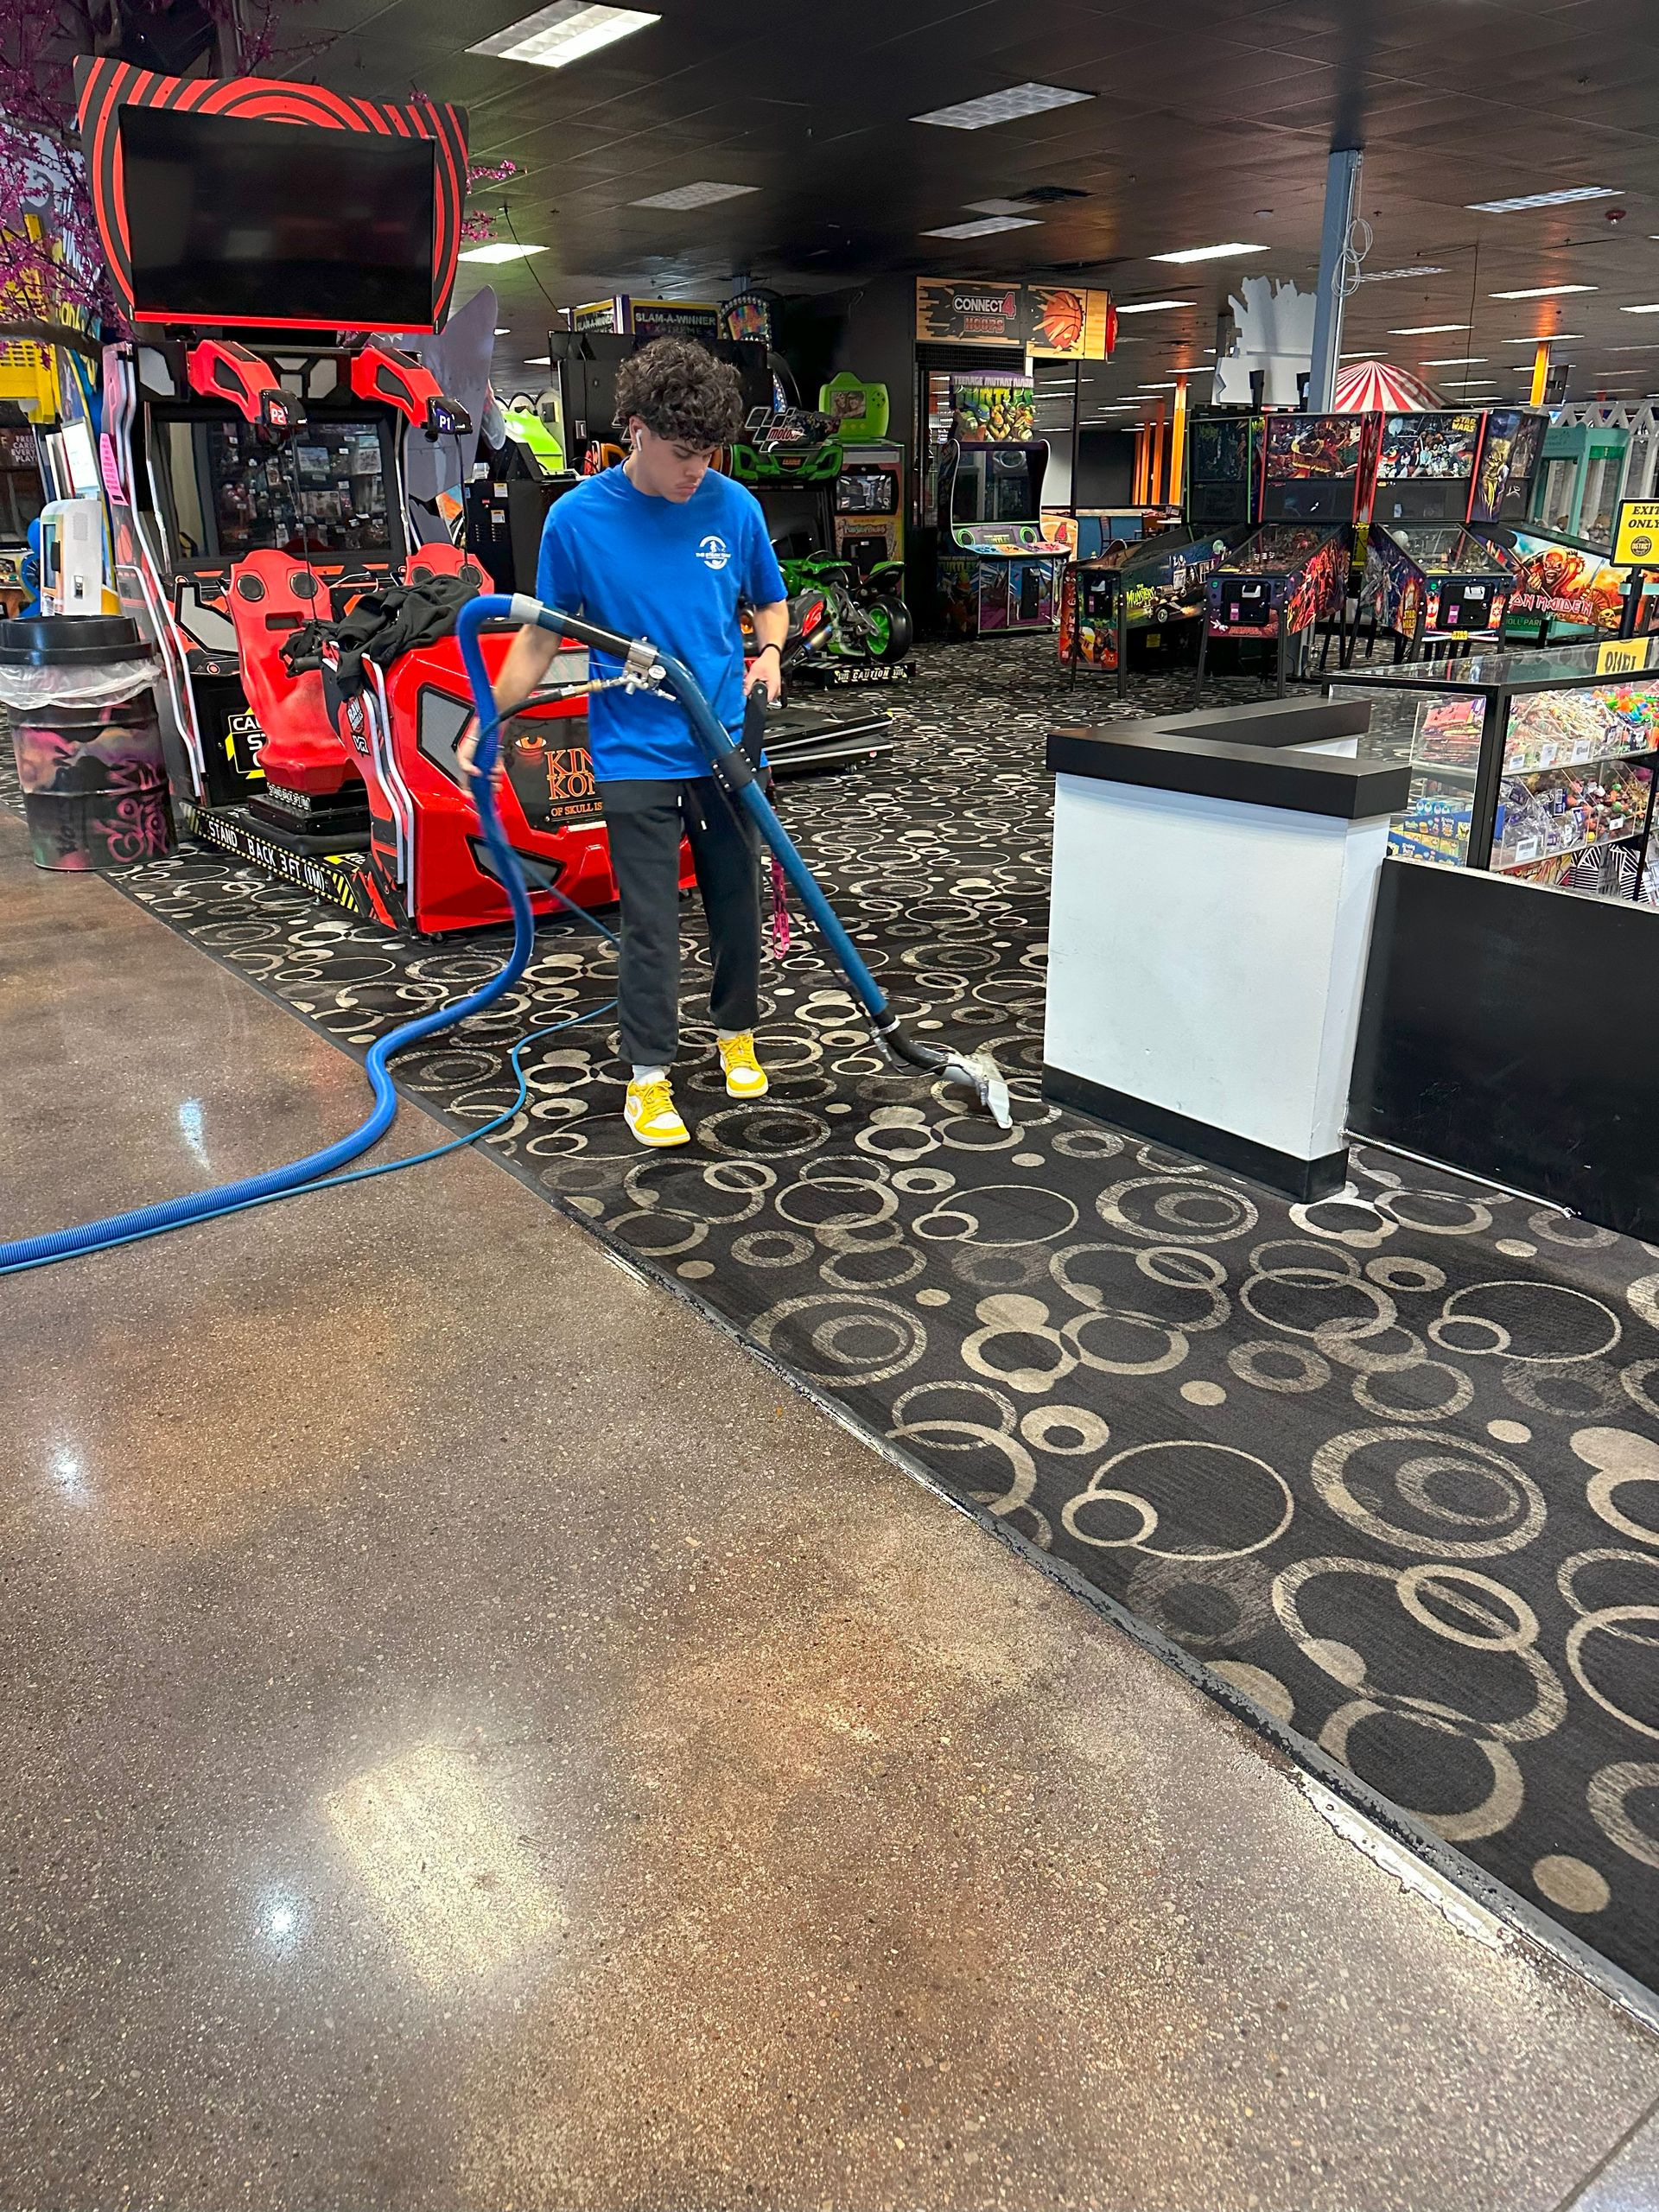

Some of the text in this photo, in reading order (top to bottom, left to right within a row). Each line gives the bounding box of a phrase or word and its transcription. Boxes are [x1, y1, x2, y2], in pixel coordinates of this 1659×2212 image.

[954, 292, 1016, 320] CONNECT 4
[635, 313, 716, 325] SLAM-A-WINNER
[963, 316, 1005, 334] HOOPS
[271, 409, 285, 423] P2
[440, 415, 451, 430] P1
[1455, 416, 1477, 424] STAR
[1452, 423, 1475, 432] WARS
[1127, 586, 1155, 607] MUNSTERS
[1536, 594, 1593, 617] MAIDEN
[853, 670, 889, 680] CAUTION
[550, 807, 563, 817] OF
[564, 804, 594, 817] SKULL
[208, 821, 238, 848] STAND
[247, 837, 276, 867] BACK
[303, 863, 326, 892] (1M)
